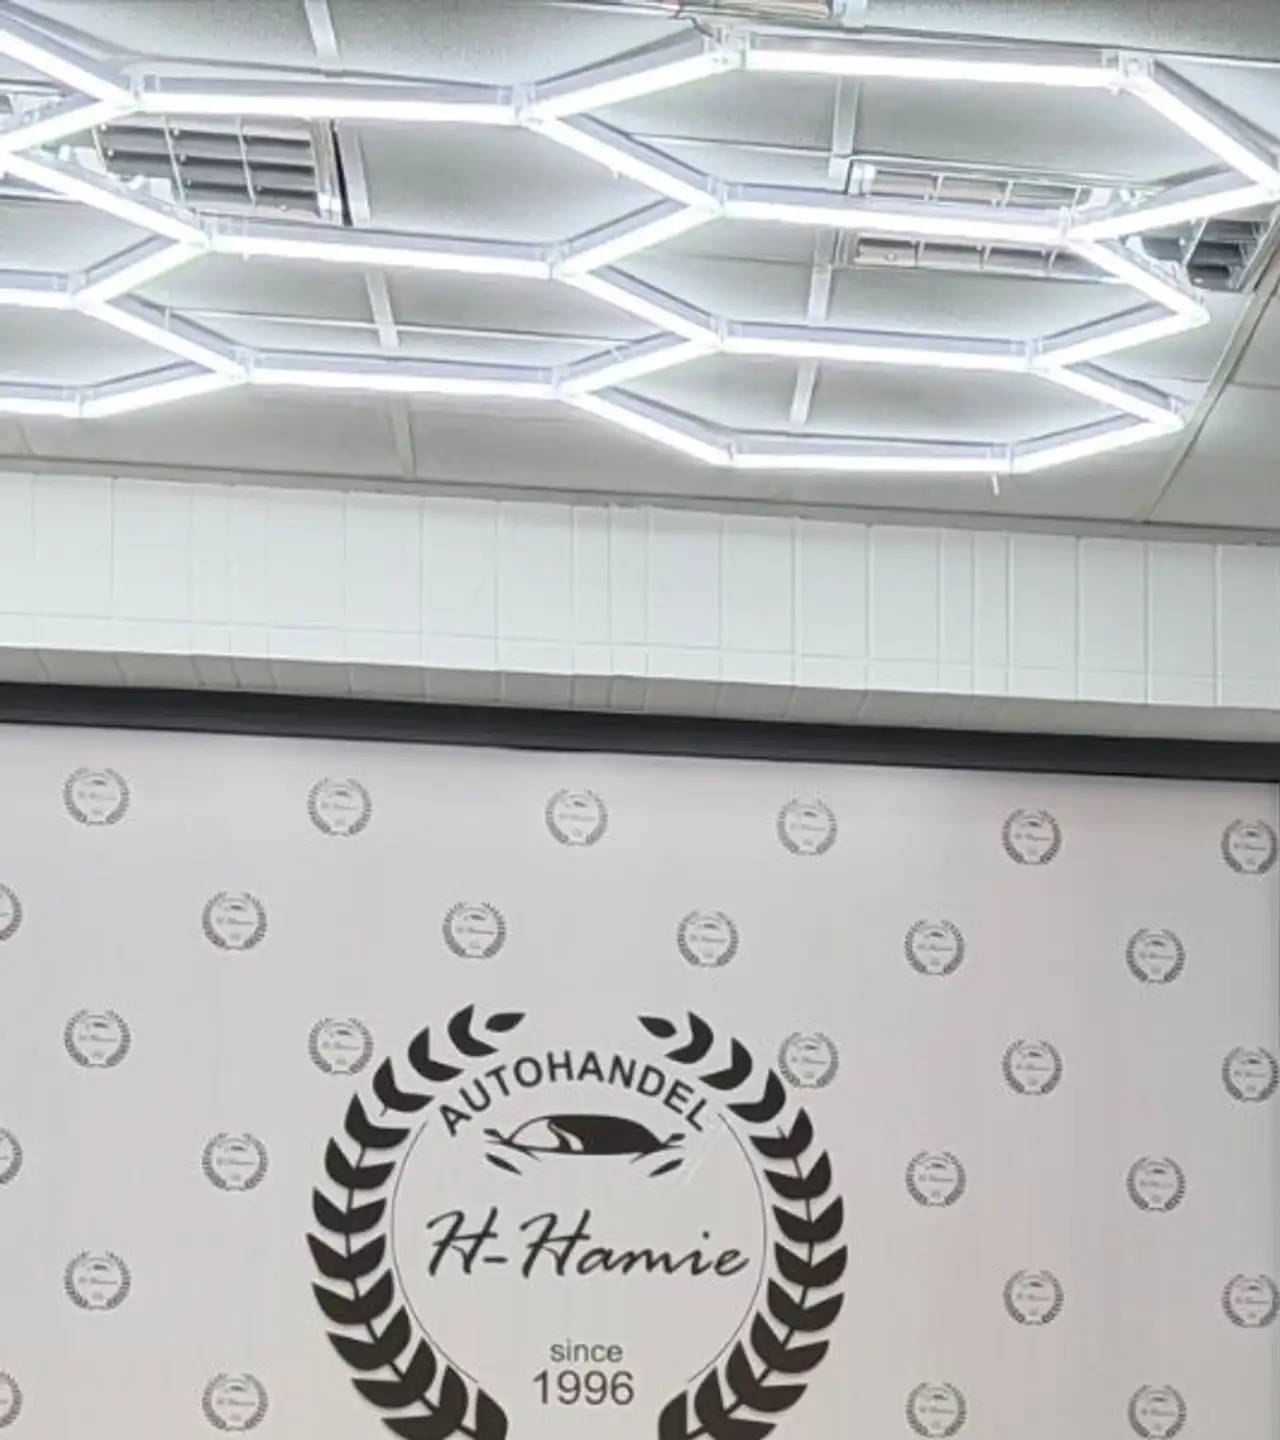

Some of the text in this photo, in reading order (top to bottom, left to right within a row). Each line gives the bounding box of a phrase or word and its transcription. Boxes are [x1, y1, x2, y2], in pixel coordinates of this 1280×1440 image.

[438, 1050, 711, 1137] AUTOHANDEL
[424, 1205, 751, 1280] H-Hamie
[549, 1338, 625, 1363] since
[531, 1369, 636, 1406] 1996
